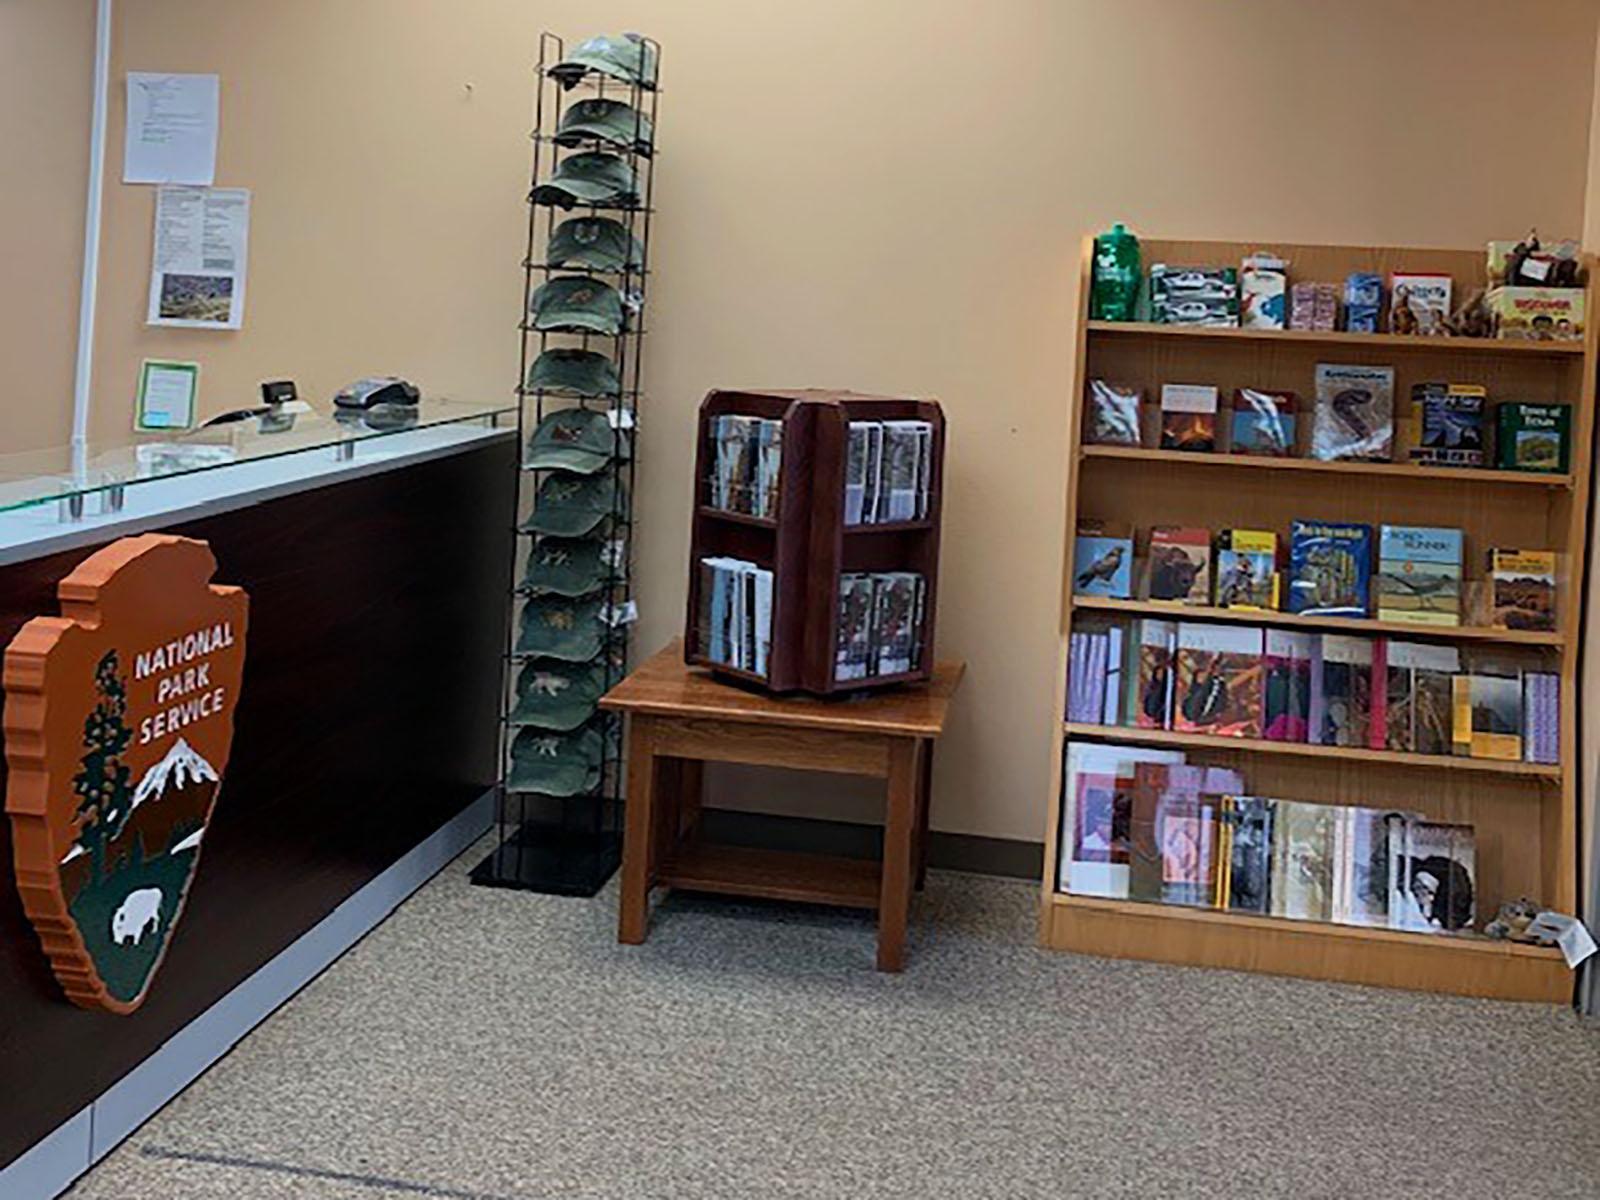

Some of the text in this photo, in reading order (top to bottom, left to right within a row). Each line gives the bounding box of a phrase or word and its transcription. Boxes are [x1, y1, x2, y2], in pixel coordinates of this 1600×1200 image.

[135, 622, 234, 679] NATIONAL
[158, 663, 209, 703] PARK
[140, 687, 225, 744] SERVICE
